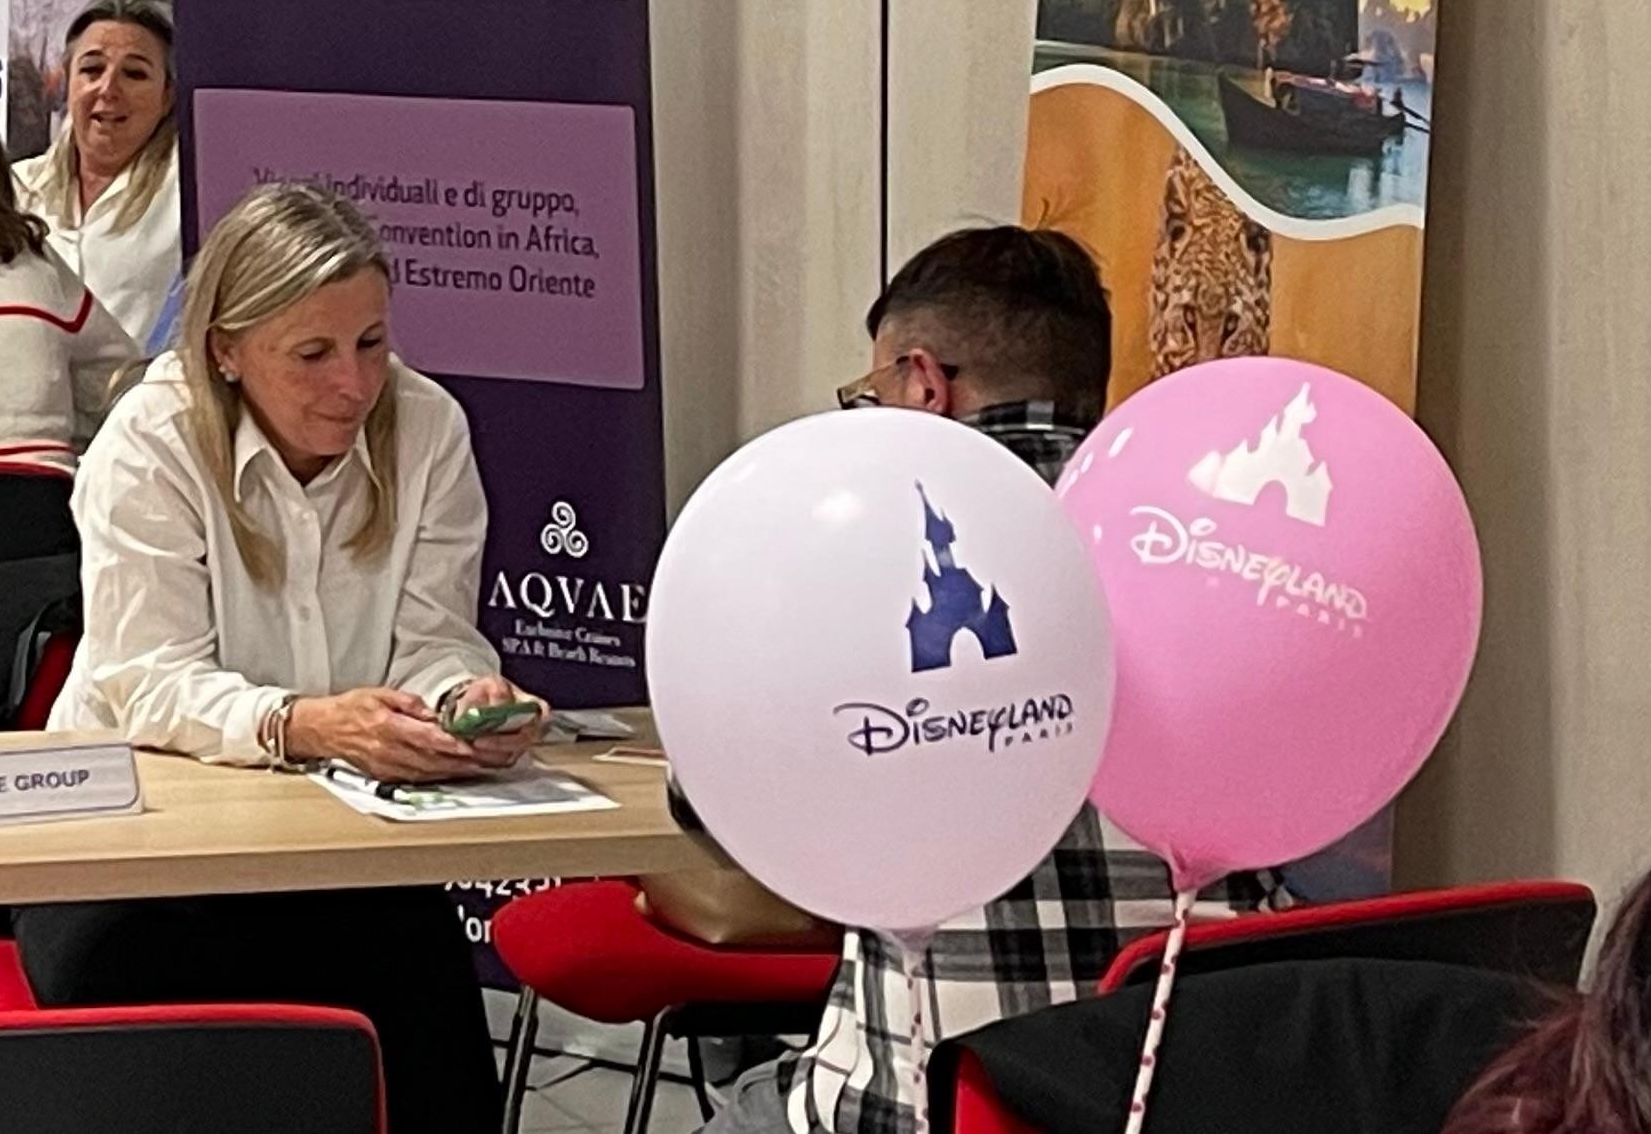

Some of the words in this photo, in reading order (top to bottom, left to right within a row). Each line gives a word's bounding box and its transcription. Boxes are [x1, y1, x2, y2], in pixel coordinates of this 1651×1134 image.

[443, 186, 459, 208] e
[464, 180, 487, 209] di
[491, 187, 581, 218] gruppo,
[379, 222, 492, 250] onvention
[498, 224, 521, 251] in
[526, 223, 601, 261] Africa,
[404, 257, 503, 292] Estremo
[508, 264, 596, 299] Oriente
[487, 569, 647, 623] AQVAE
[13, 768, 90, 792] GROUP
